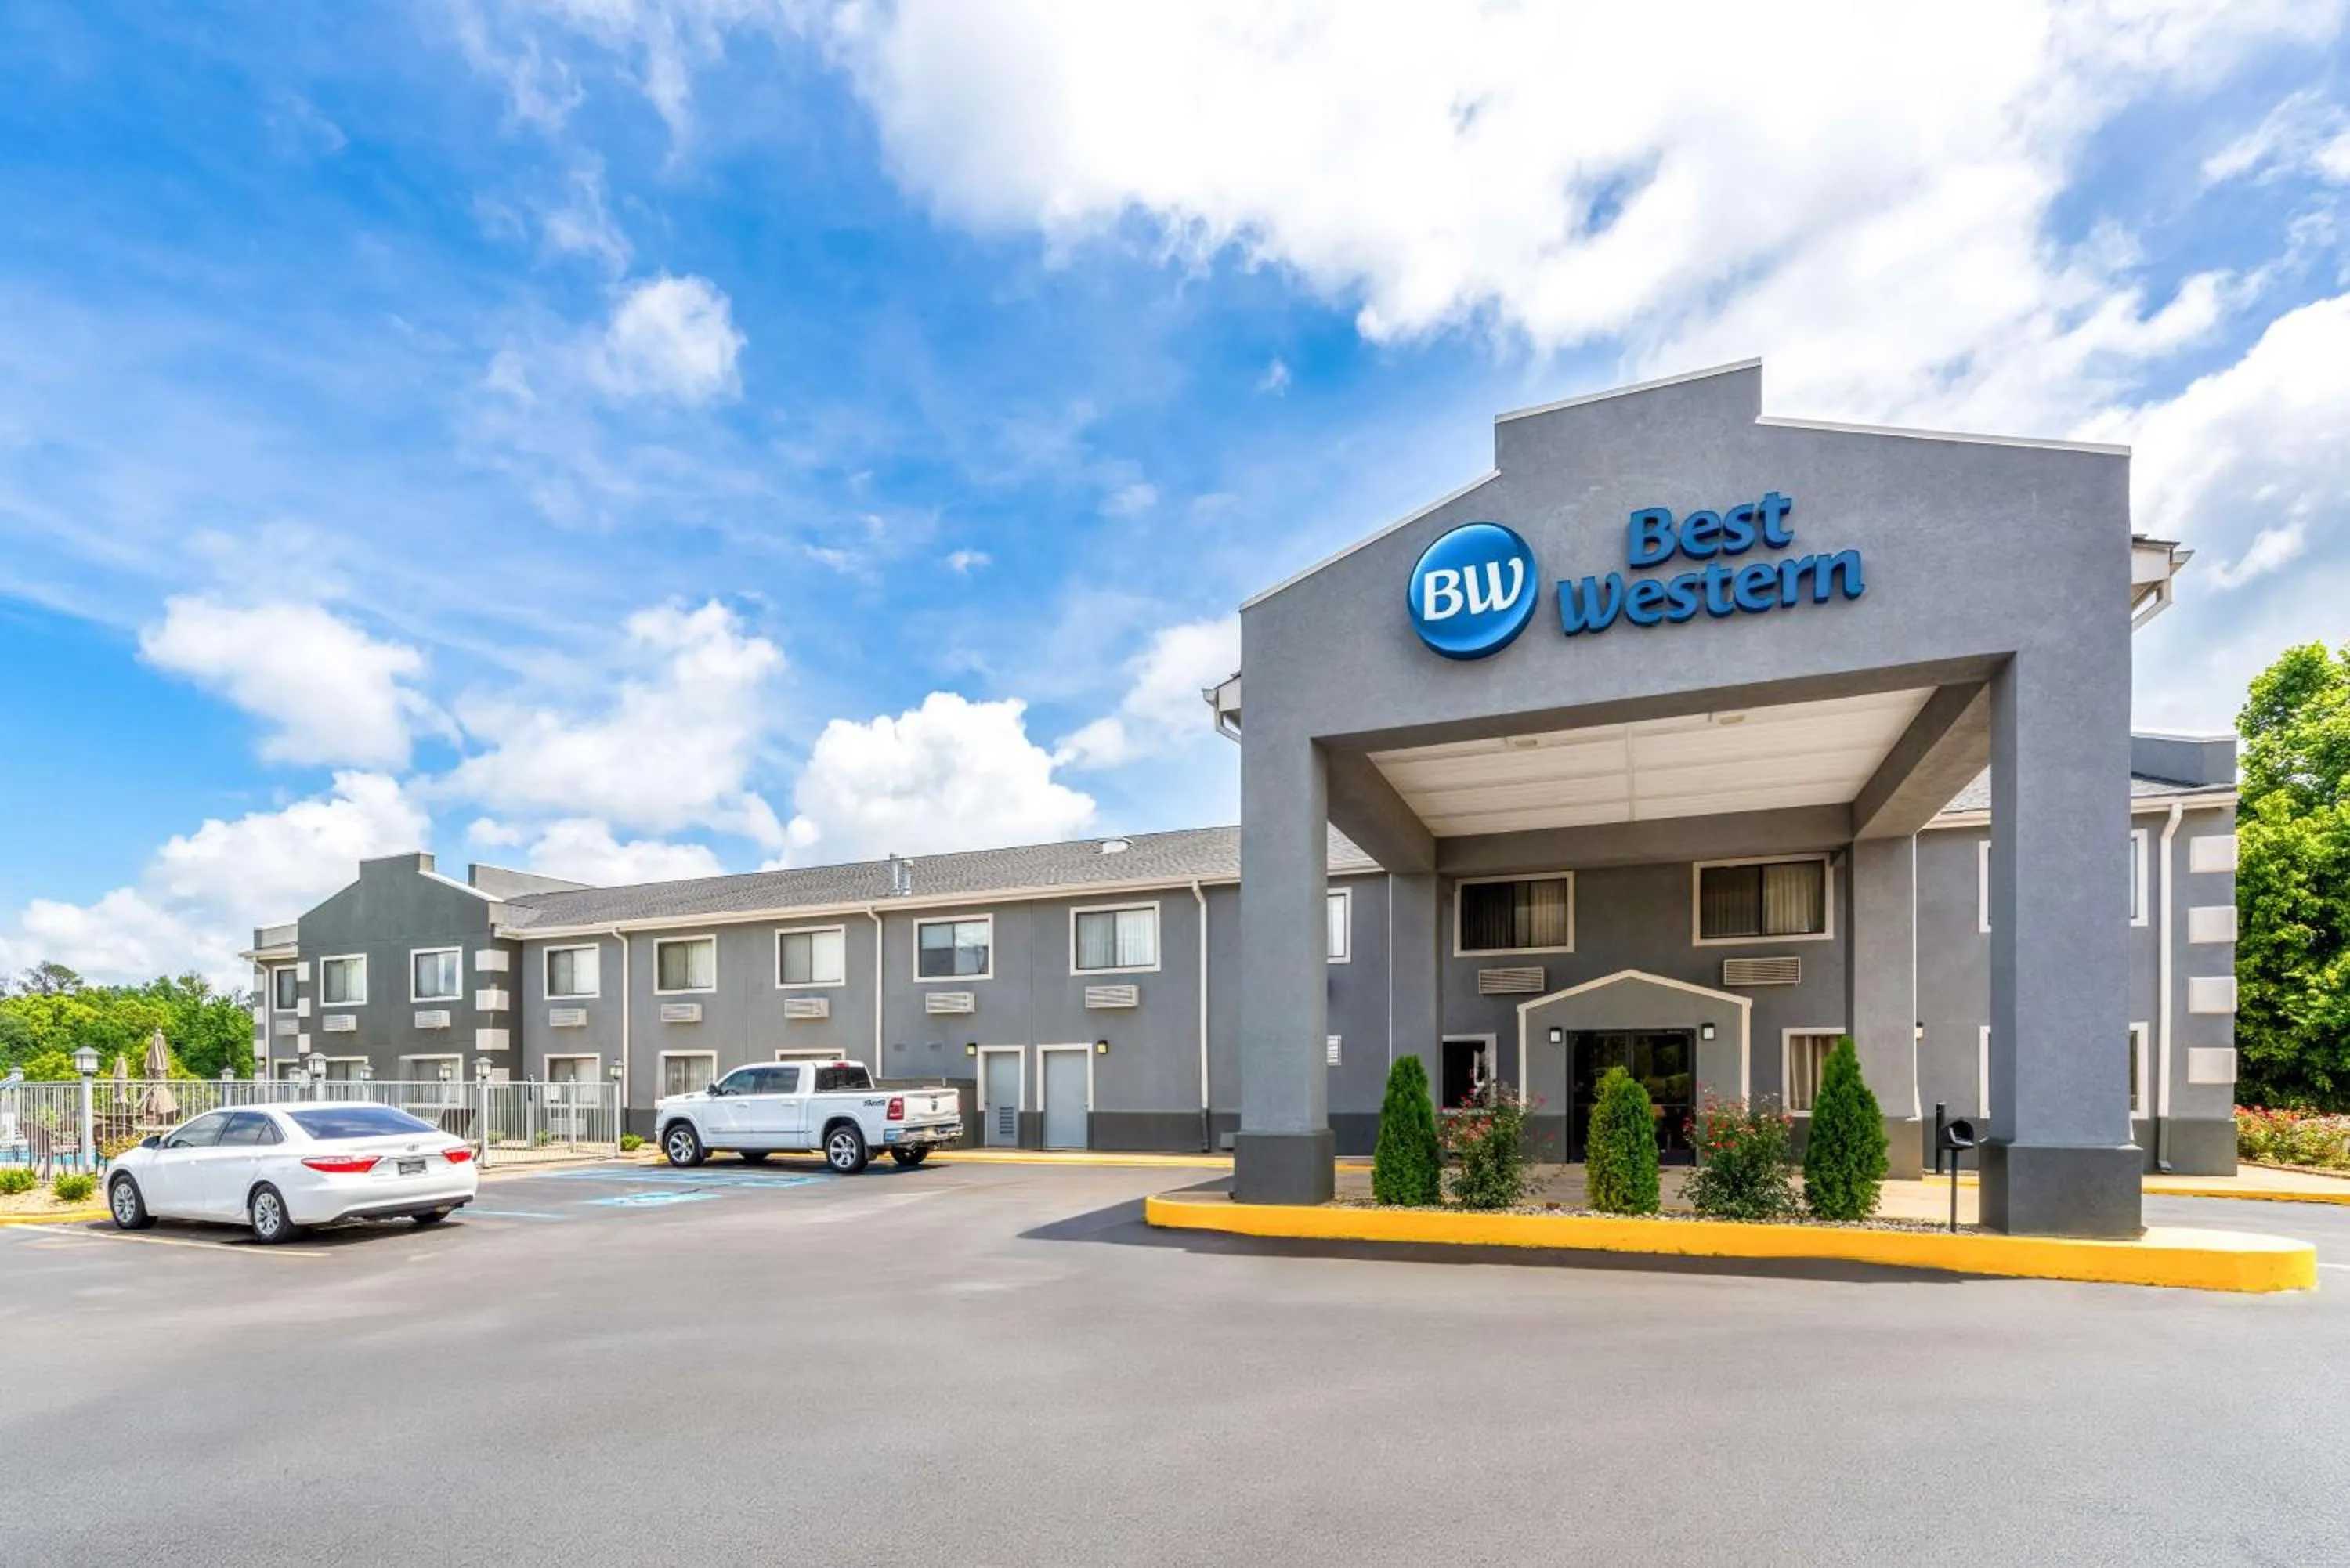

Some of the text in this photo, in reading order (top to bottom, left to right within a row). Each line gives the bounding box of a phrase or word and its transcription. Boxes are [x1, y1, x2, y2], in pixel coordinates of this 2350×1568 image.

[1629, 491, 1794, 569] Best
[1423, 557, 1524, 621] BW
[1556, 549, 1865, 636] Western
